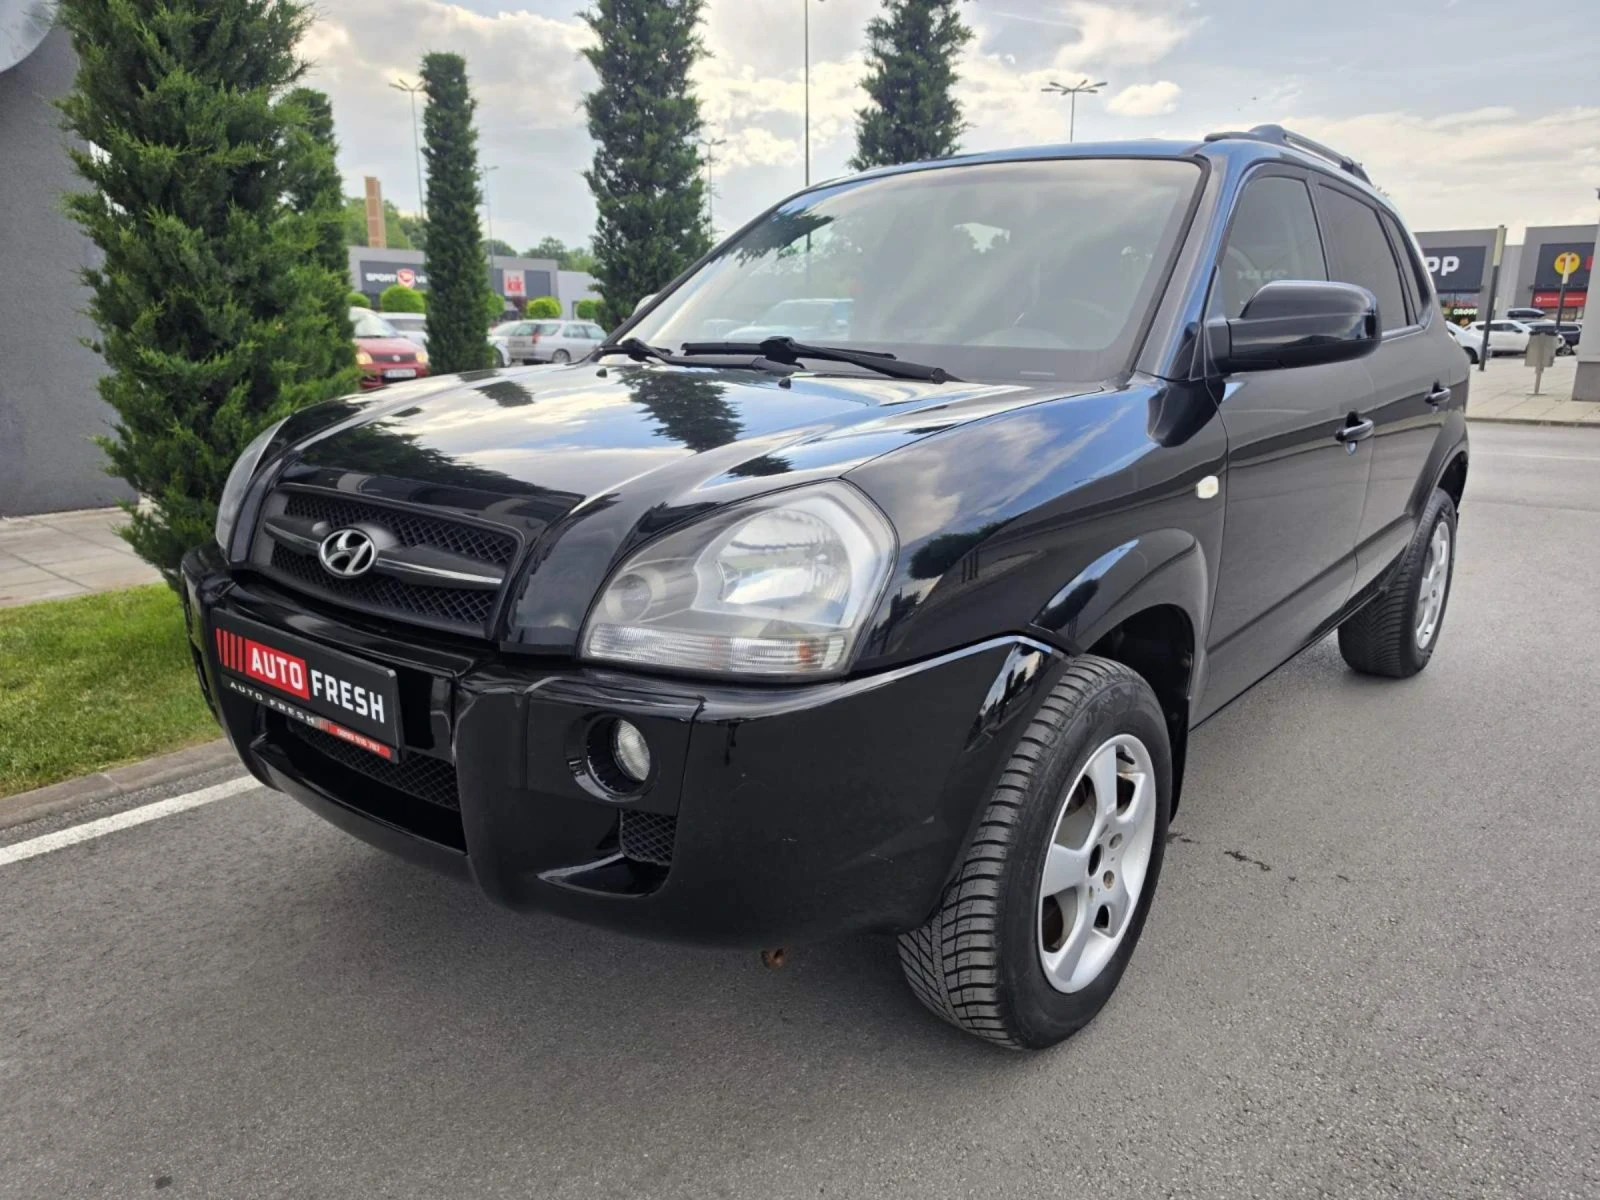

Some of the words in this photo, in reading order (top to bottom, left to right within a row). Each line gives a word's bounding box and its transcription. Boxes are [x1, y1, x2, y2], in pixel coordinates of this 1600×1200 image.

[365, 272, 397, 282] SPORT
[229, 681, 263, 701] AUTO
[269, 699, 316, 725] FRESH
[252, 647, 303, 690] AUTO
[310, 669, 385, 724] FRESH
